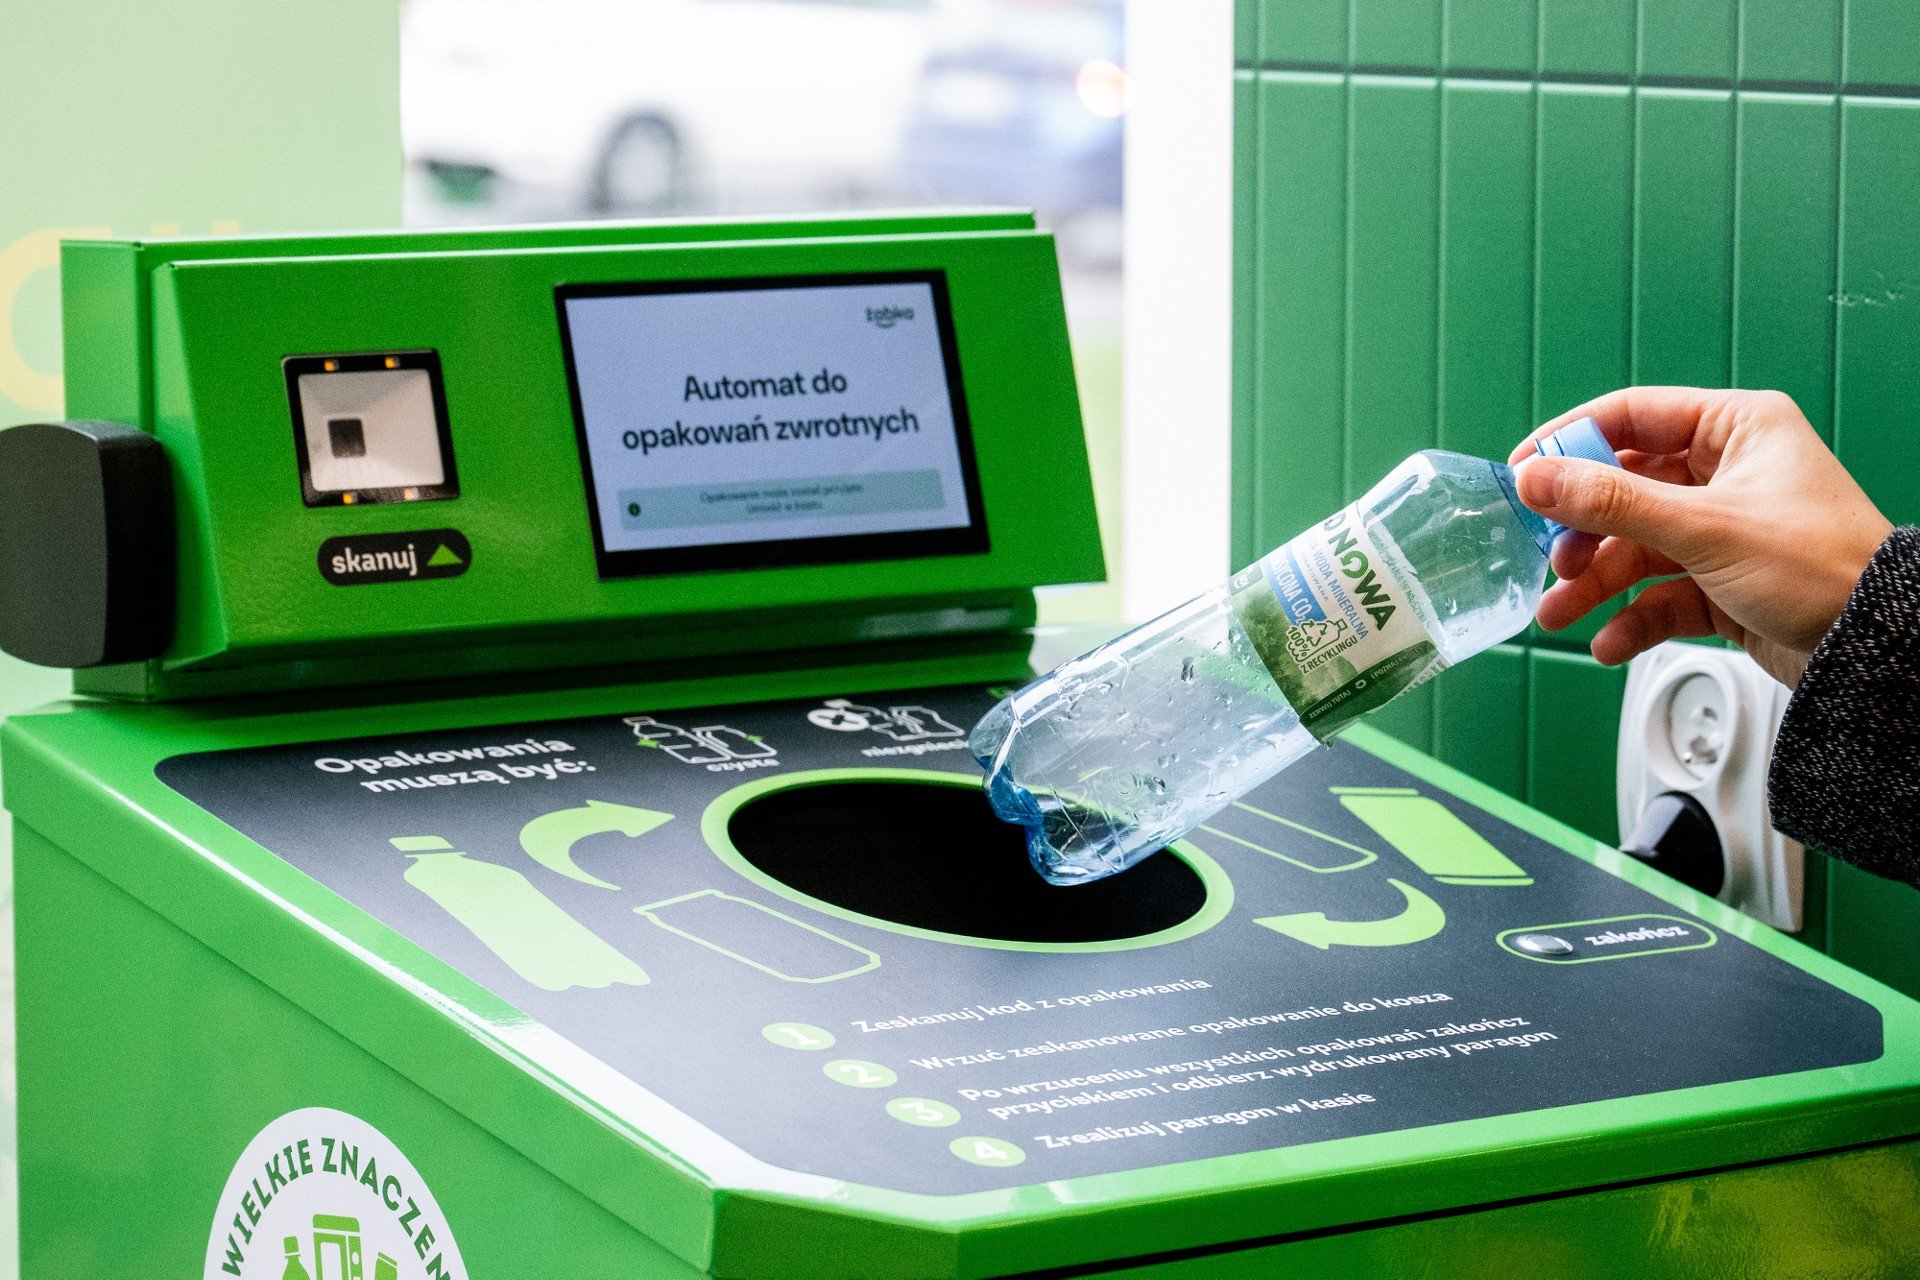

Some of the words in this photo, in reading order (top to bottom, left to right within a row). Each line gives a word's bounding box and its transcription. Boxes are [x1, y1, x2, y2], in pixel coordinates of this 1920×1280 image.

[684, 373, 806, 401] Automat
[811, 368, 847, 394] do
[622, 415, 769, 456] opakowań
[775, 408, 919, 441] zwrotnych
[332, 545, 417, 576] skanuj
[1328, 527, 1397, 631] NOWA
[1313, 549, 1334, 580] WODA
[1328, 579, 1369, 639] MINERALNA
[1287, 626, 1310, 657] 100%
[1300, 665, 1309, 674] Z
[1308, 635, 1358, 671] RECYKLINGU
[1331, 689, 1352, 704] TUTAJ
[314, 739, 576, 774] Opakowania
[360, 768, 510, 793] muszą
[497, 757, 597, 780] być:
[1584, 923, 1689, 948] zakończ
[780, 1026, 819, 1045] 1
[851, 1007, 984, 1033] Zeskanuj
[976, 1000, 1036, 1017] kod
[1036, 1000, 1056, 1009] z
[1058, 979, 1213, 1007] opakowania
[840, 1063, 882, 1083] 2
[909, 1048, 1006, 1071] Wrzuć
[1008, 1027, 1188, 1060] zeskanowane
[1189, 1006, 1341, 1035] opakowanie
[1342, 1001, 1376, 1014] do
[1373, 992, 1453, 1009] kosza
[901, 1102, 943, 1122] 3
[958, 1088, 1002, 1101] Po
[1002, 1068, 1148, 1095] wrzuceniu
[1146, 1046, 1297, 1079] wszystkich
[1296, 1028, 1427, 1056] opakowań
[1425, 1015, 1532, 1038] zakończ
[987, 1086, 1156, 1121] przyciskiem
[1152, 1082, 1170, 1094] i
[1171, 1068, 1273, 1092] odbierz
[1271, 1045, 1452, 1078] wydrukowany
[1450, 1028, 1559, 1056] paragon
[974, 1141, 1010, 1162] 4
[1034, 1121, 1167, 1149] Zrealizuj
[1161, 1104, 1279, 1135] paragon
[1276, 1101, 1301, 1116] w
[1298, 1092, 1377, 1110] kasie
[221, 1138, 314, 1278] WIELKIE
